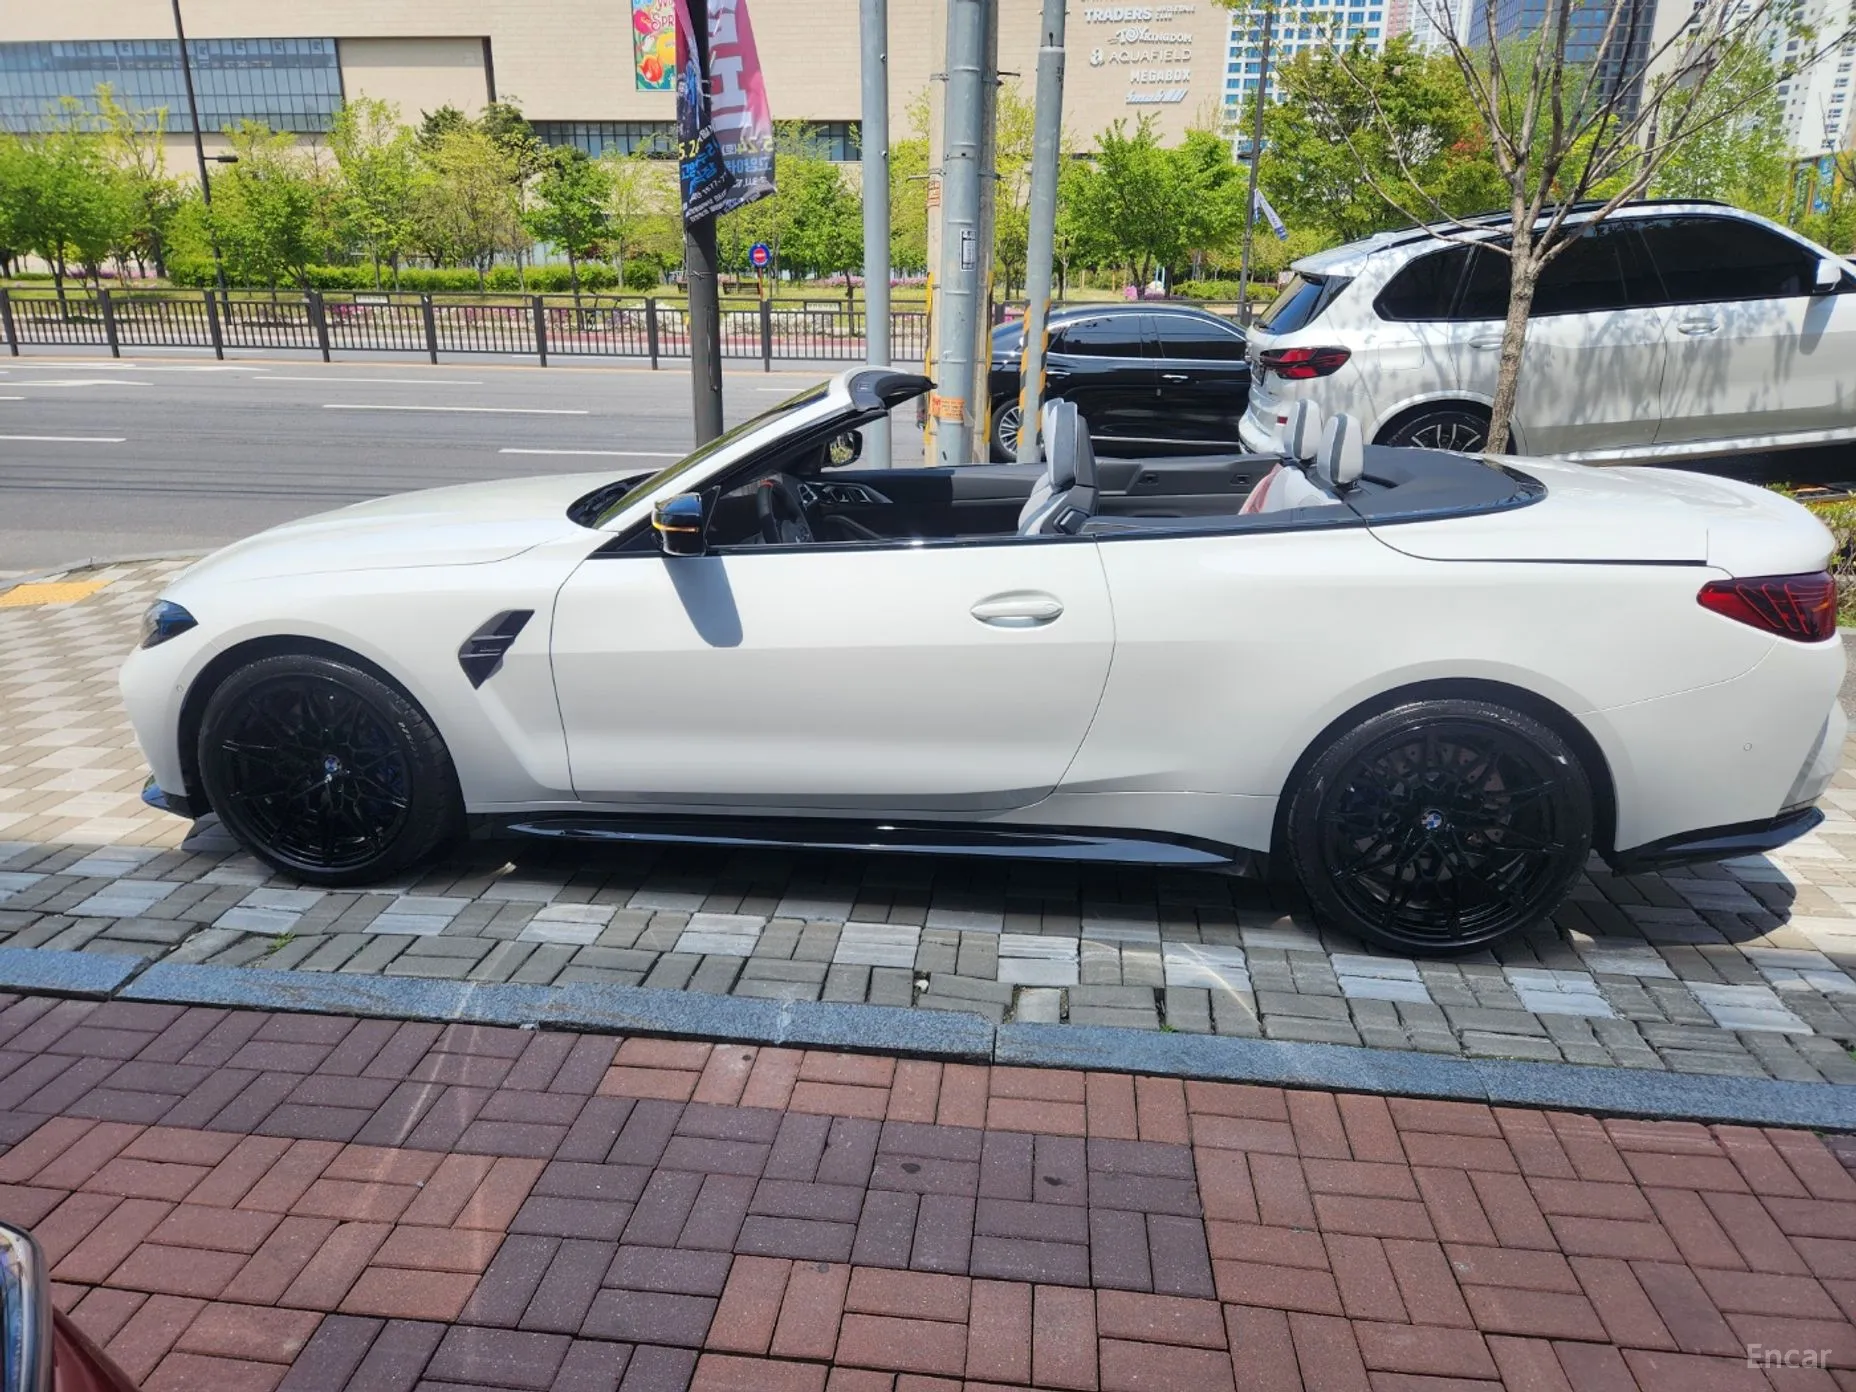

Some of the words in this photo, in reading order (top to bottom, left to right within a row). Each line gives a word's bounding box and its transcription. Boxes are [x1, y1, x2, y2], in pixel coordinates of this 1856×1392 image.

[1084, 6, 1153, 23] TRADERS
[1109, 49, 1192, 65] AQUAFIELD
[1129, 69, 1191, 84] MEGABOX
